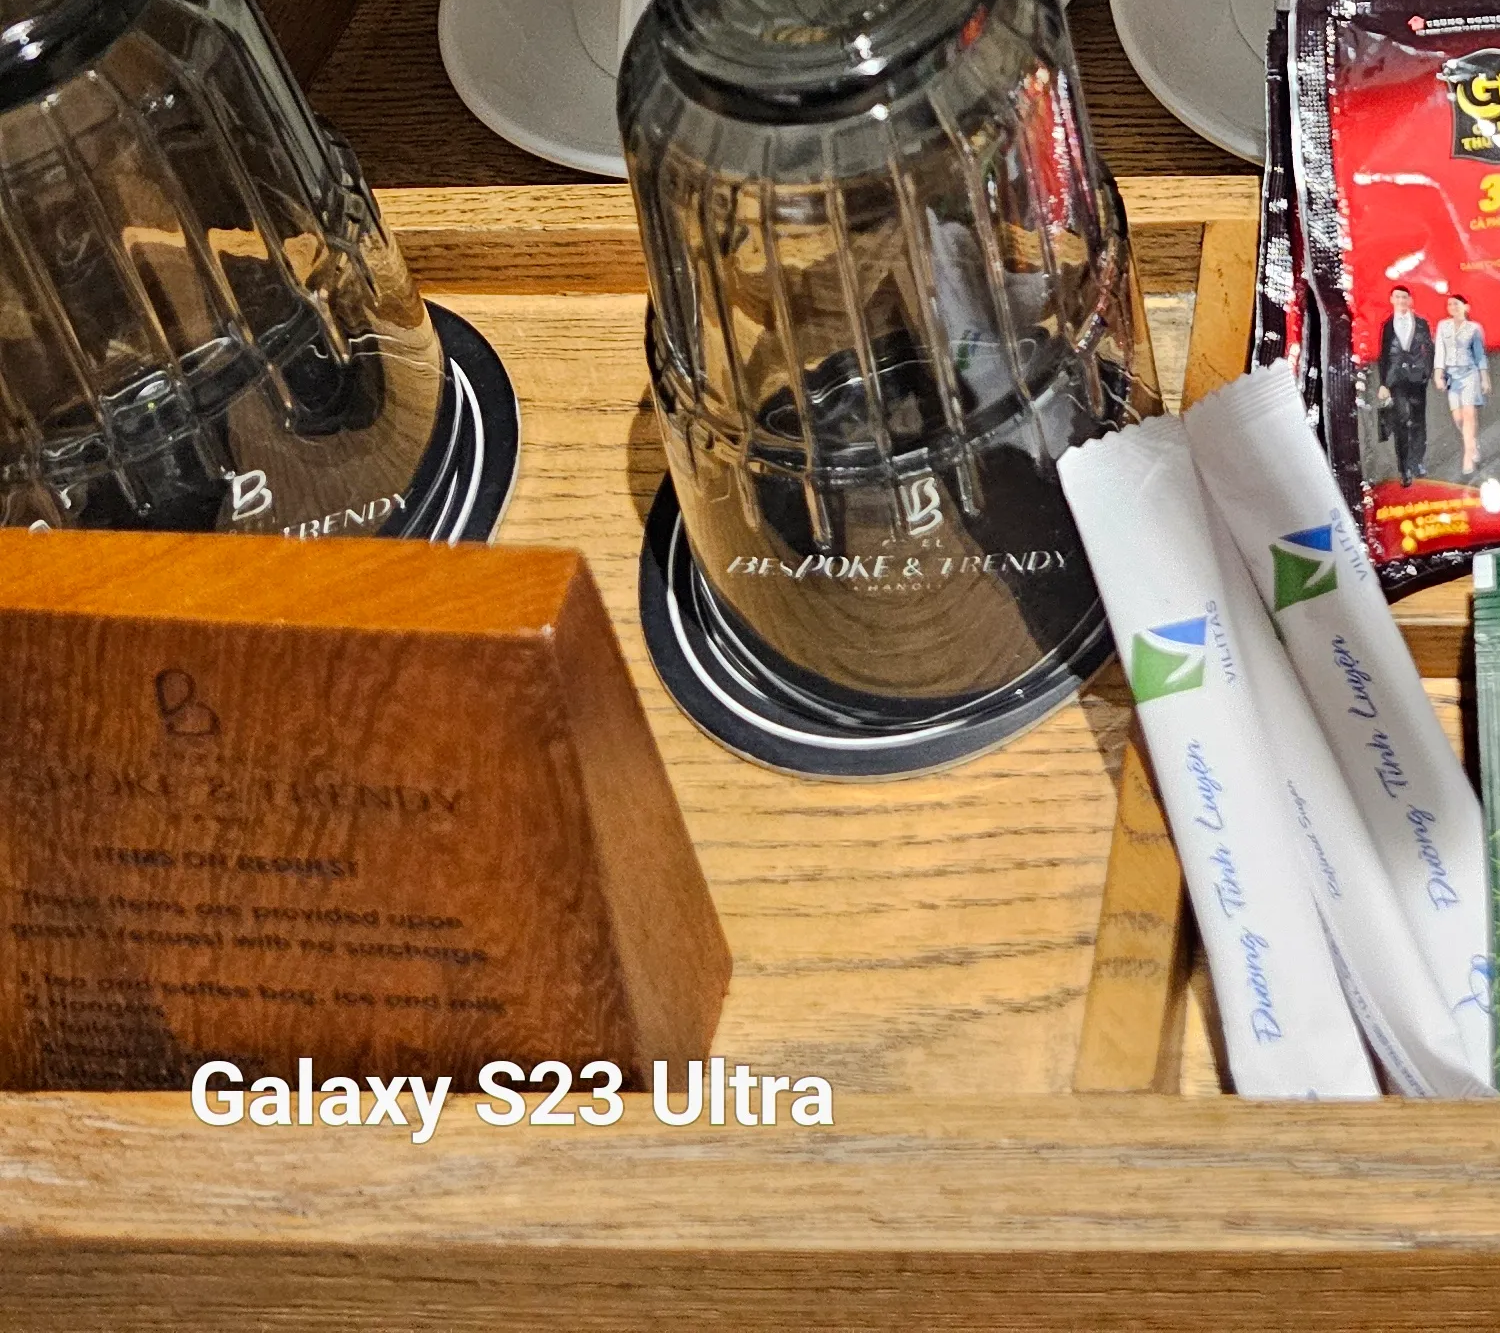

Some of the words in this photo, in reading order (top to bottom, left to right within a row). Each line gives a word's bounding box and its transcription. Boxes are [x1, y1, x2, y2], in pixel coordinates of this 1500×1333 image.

[903, 557, 924, 577] &
[1328, 507, 1369, 583] VILITAS
[1206, 599, 1237, 686] VILITAS
